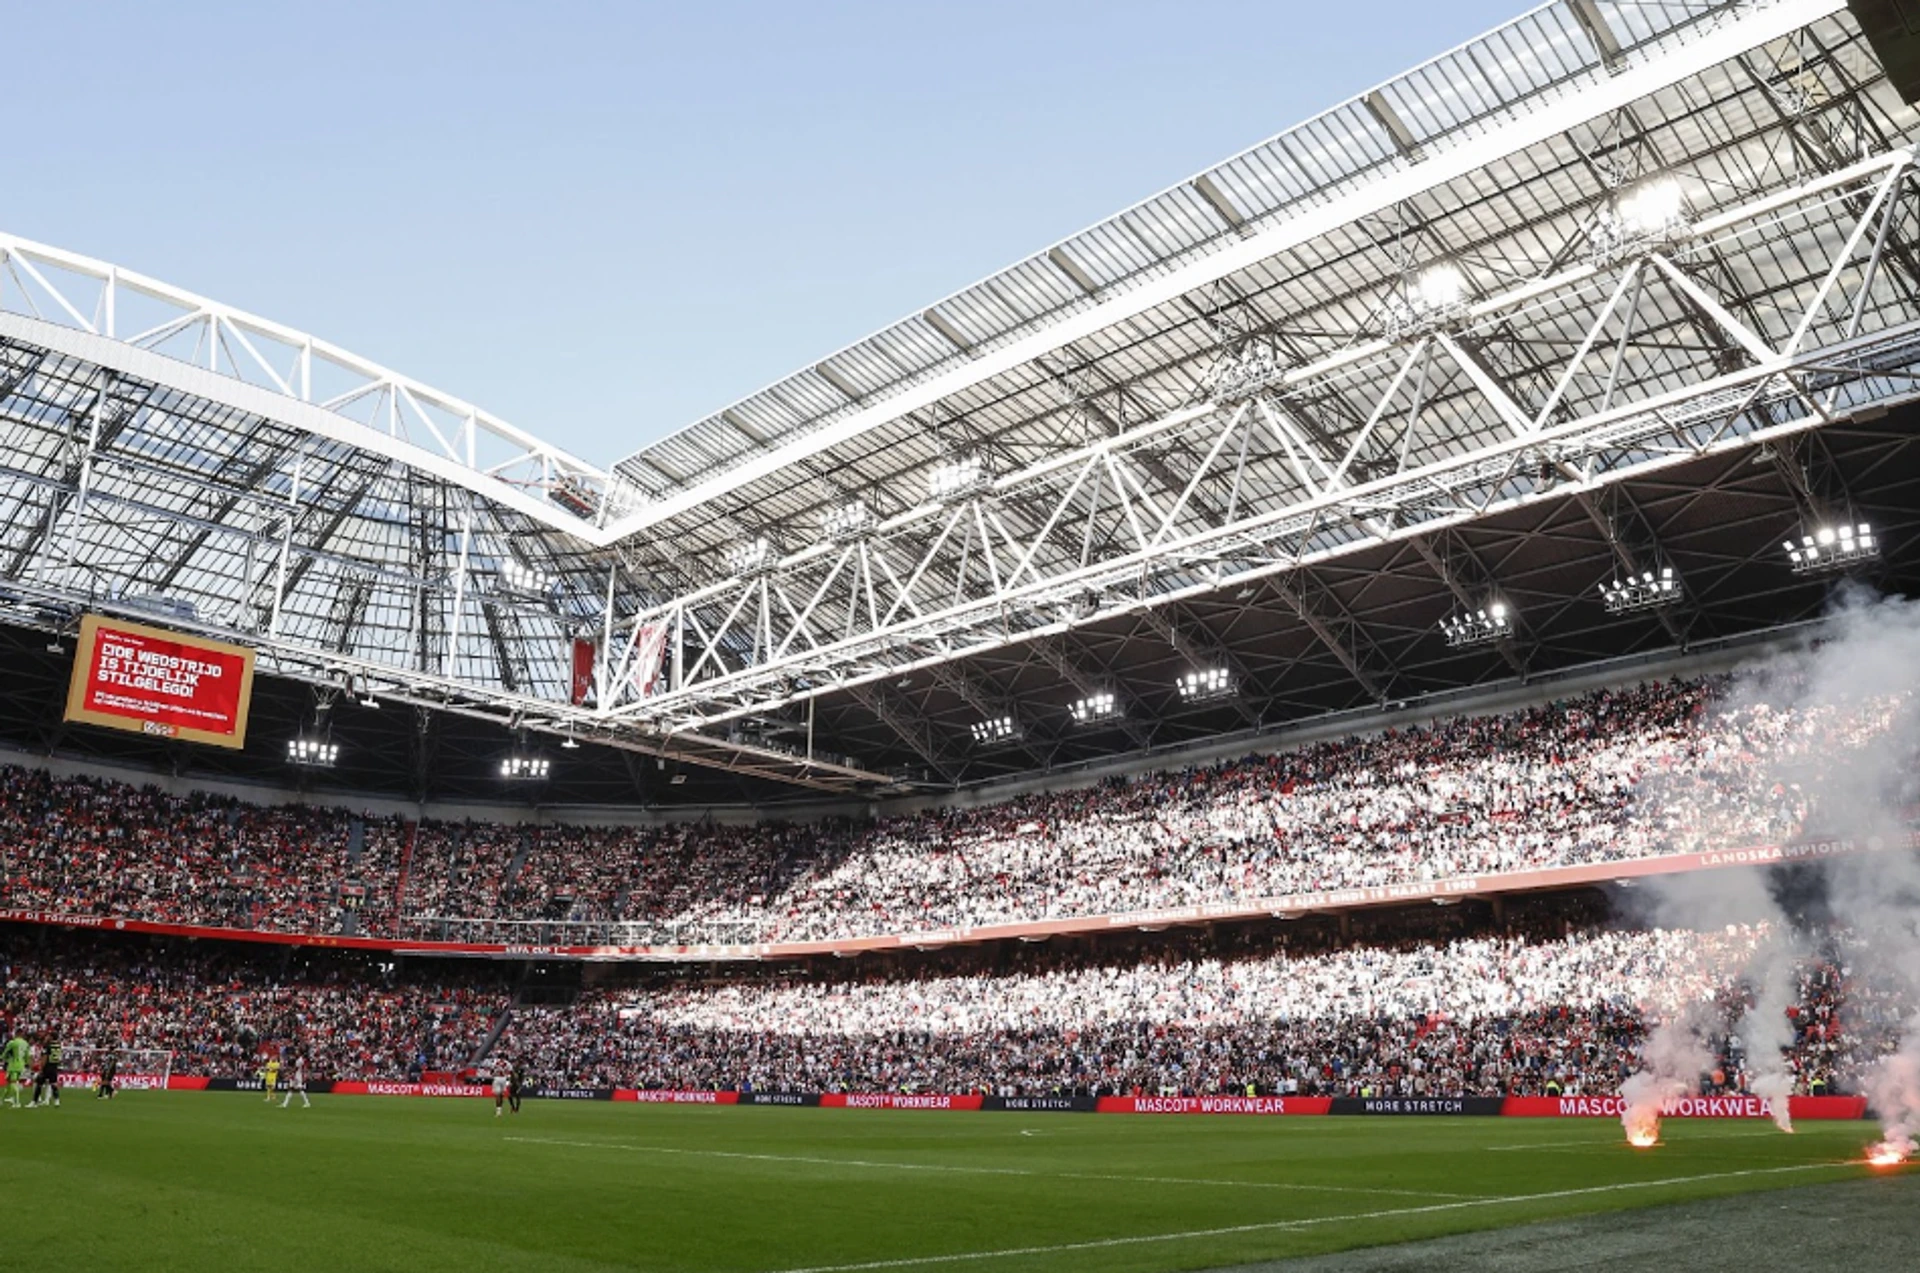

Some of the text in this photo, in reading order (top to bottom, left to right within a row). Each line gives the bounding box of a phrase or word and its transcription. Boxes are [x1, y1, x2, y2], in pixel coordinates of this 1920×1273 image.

[100, 656, 199, 686] IS TIJDELIJK
[137, 650, 222, 677] WEDSTRIJD
[97, 669, 194, 697] STILGELEGD!
[1701, 841, 1855, 866] LANDSKAMPIOEN
[1389, 884, 1436, 897] MAART
[1444, 880, 1477, 892] 1900
[421, 1085, 483, 1096] WORKWEAR
[892, 1096, 950, 1109] WORKWEAR
[1005, 1099, 1072, 1109] MORE STRETCH
[1201, 1098, 1285, 1113] WORKWEAR
[1365, 1100, 1463, 1113] MORE STRETCH
